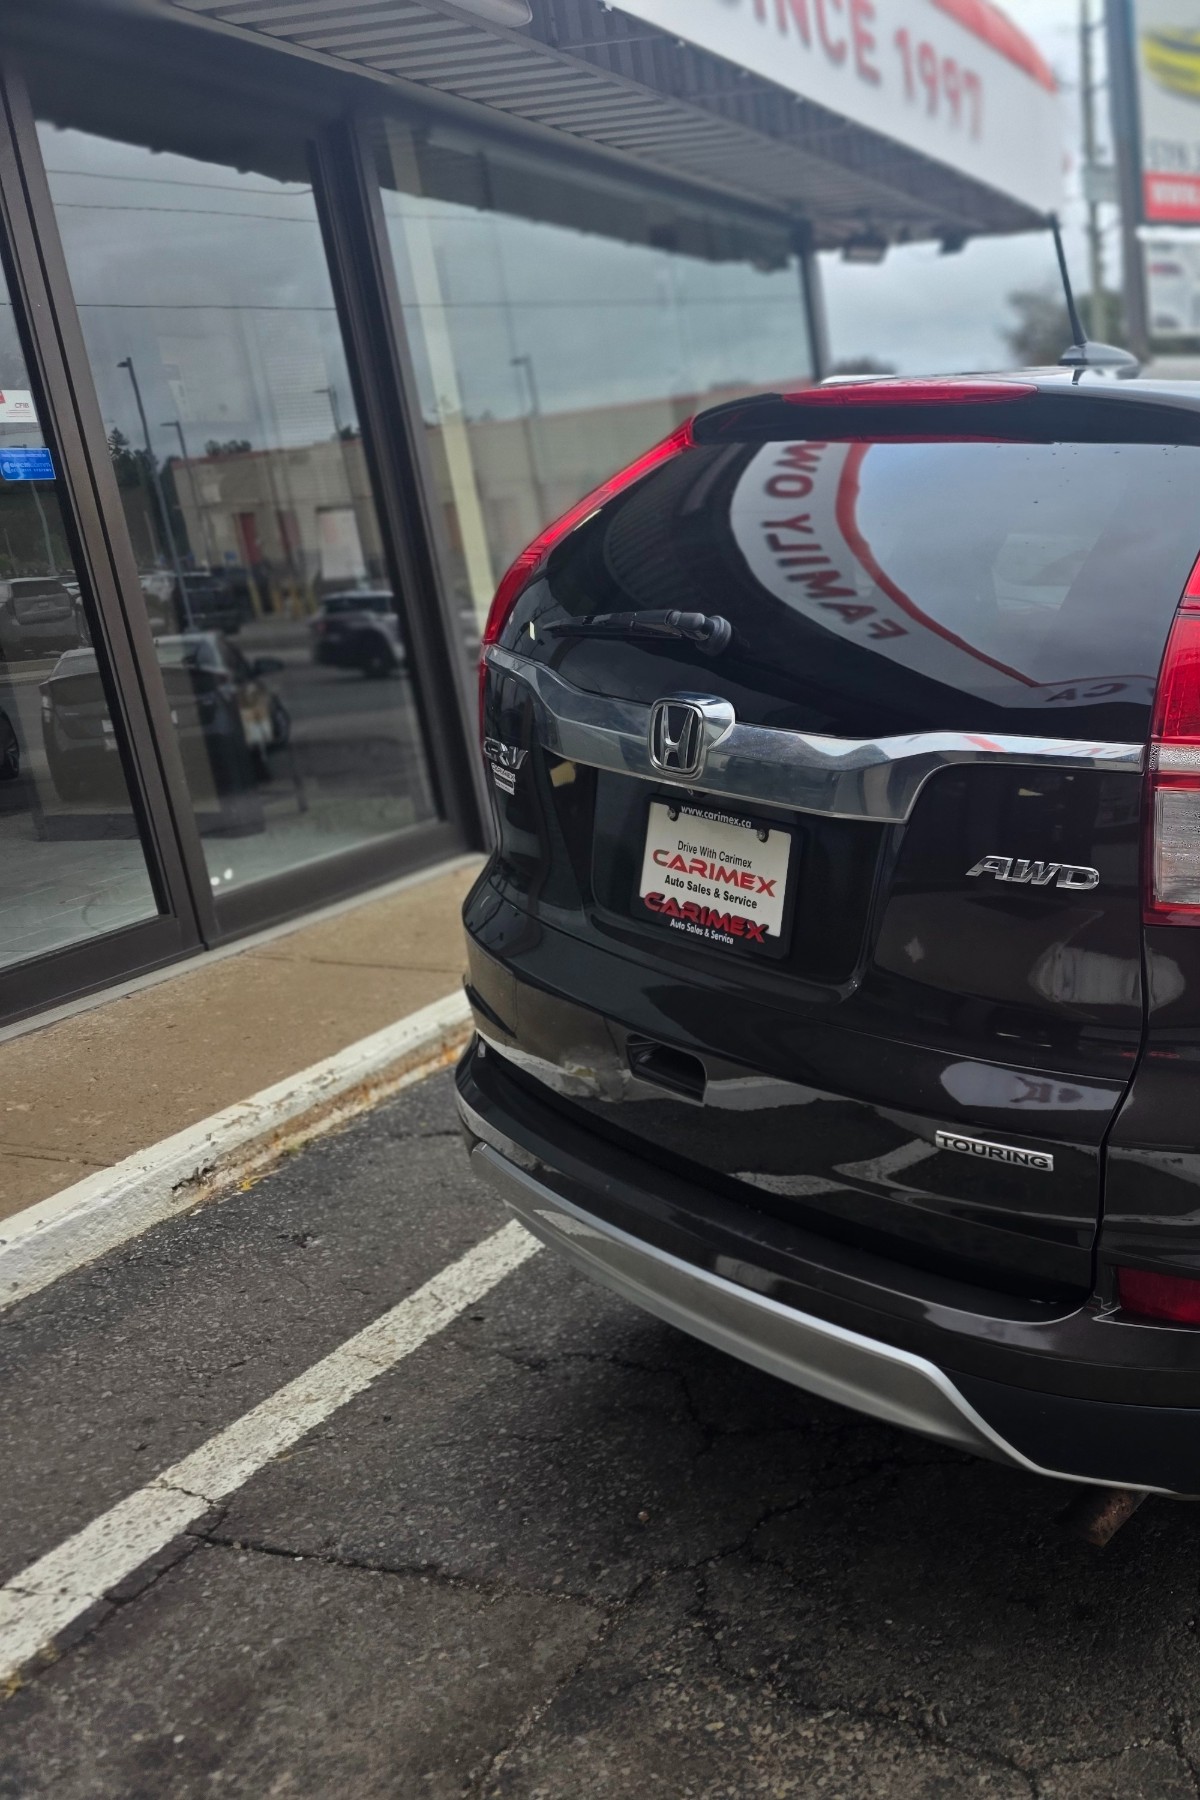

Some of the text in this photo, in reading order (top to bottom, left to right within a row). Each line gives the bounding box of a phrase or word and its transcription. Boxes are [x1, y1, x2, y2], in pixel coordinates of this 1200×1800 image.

[893, 26, 983, 144] 1997
[680, 805, 752, 829] www.carimex.ca
[677, 840, 753, 869] Drive With Carimex
[652, 848, 778, 898] CARIMEX
[965, 855, 1100, 890] AWD
[664, 875, 758, 909] Auto Sales & Service
[643, 891, 770, 943] CARIMEX
[670, 918, 734, 945] Auto Sales & Service
[937, 1134, 1050, 1170] TOURING
